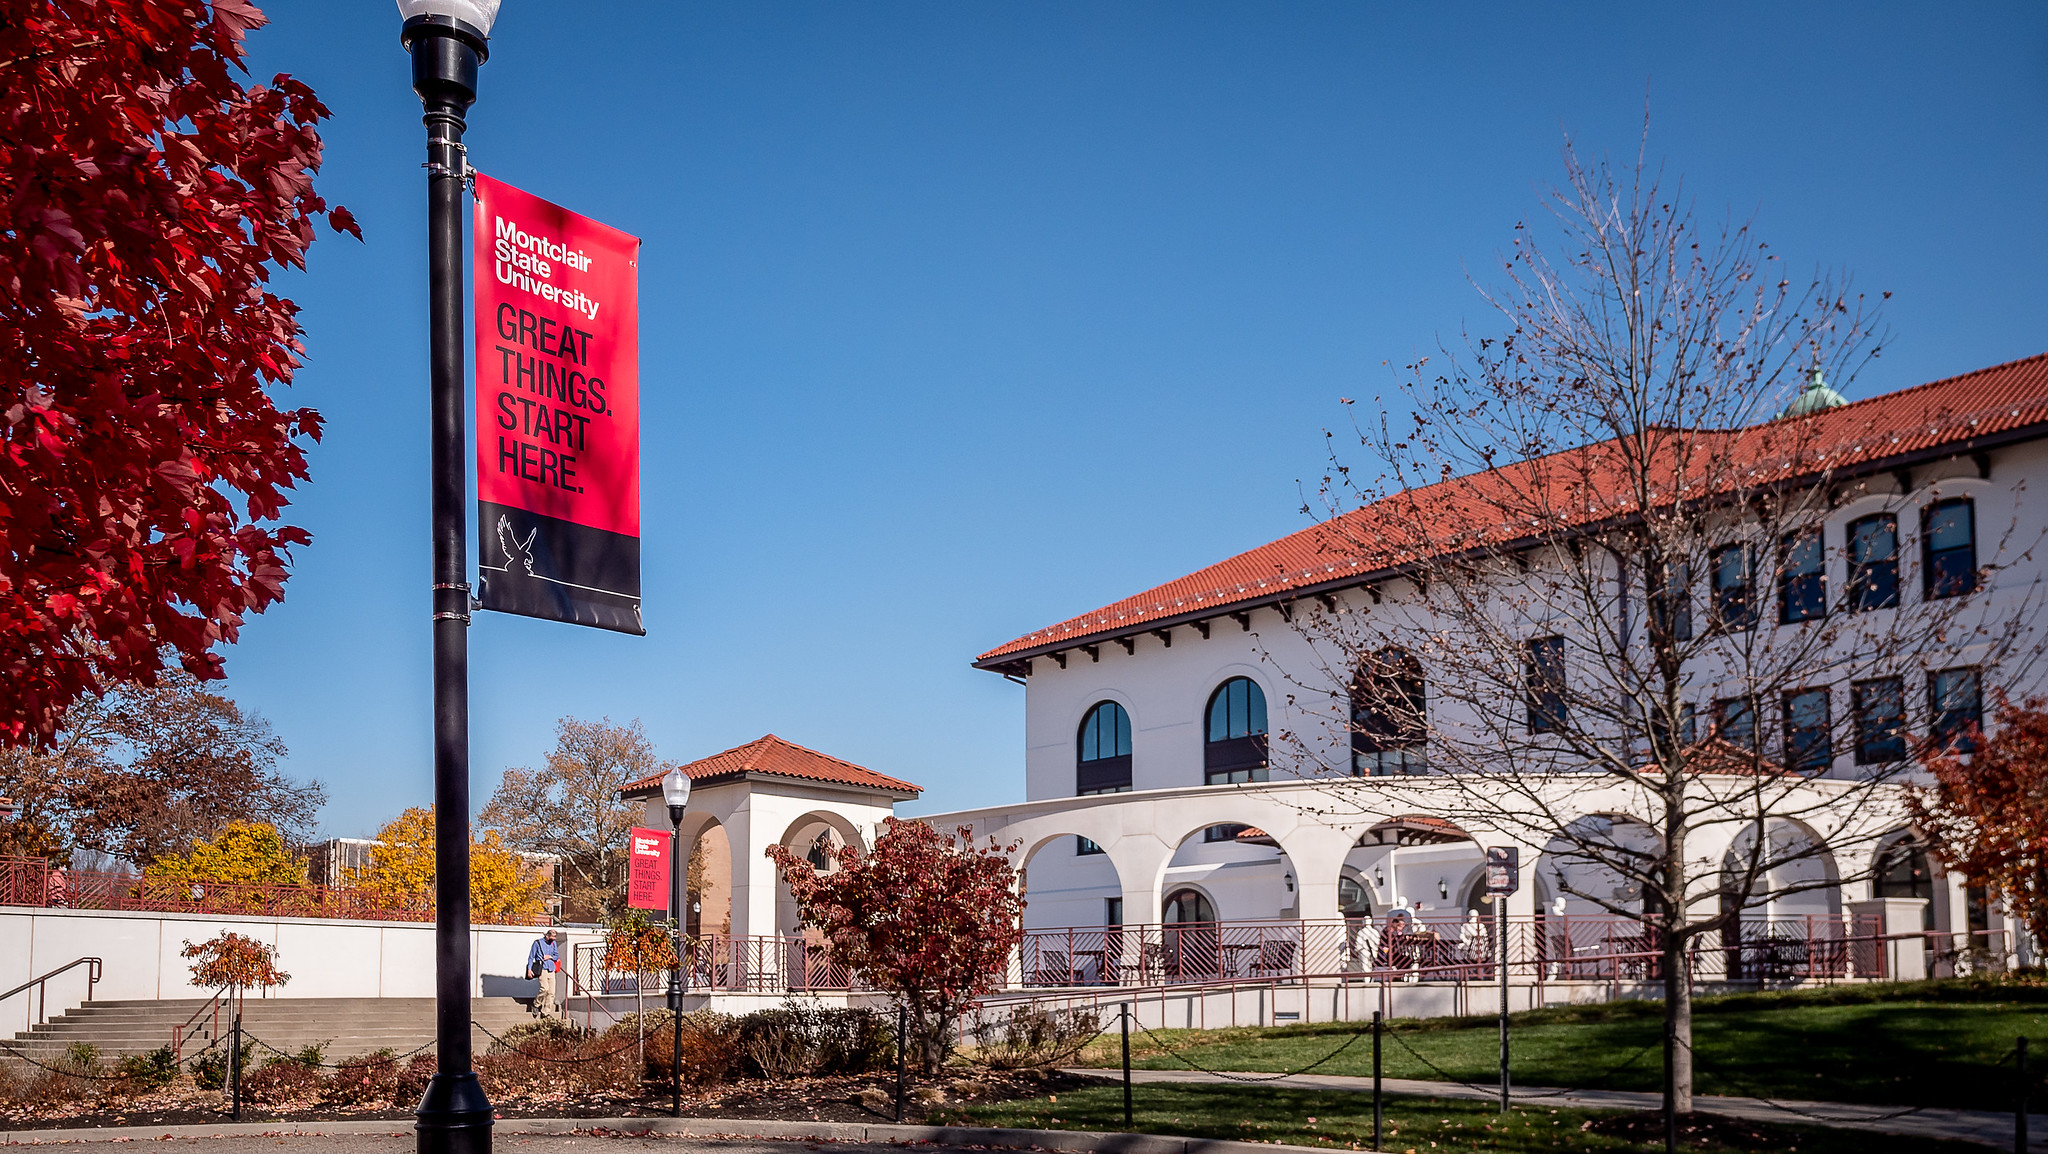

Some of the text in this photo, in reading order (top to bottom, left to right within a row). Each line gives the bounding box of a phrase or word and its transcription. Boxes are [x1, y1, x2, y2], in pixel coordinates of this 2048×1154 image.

[494, 238, 551, 278] State
[495, 216, 592, 273] Montclair
[495, 259, 599, 320] University
[496, 302, 593, 366] GREAT
[495, 345, 612, 417] THINGS.
[497, 392, 590, 451] START
[498, 436, 584, 494] HERE.
[634, 869, 662, 880] THINGS.
[634, 880, 656, 890] START
[635, 858, 657, 869] GREAT
